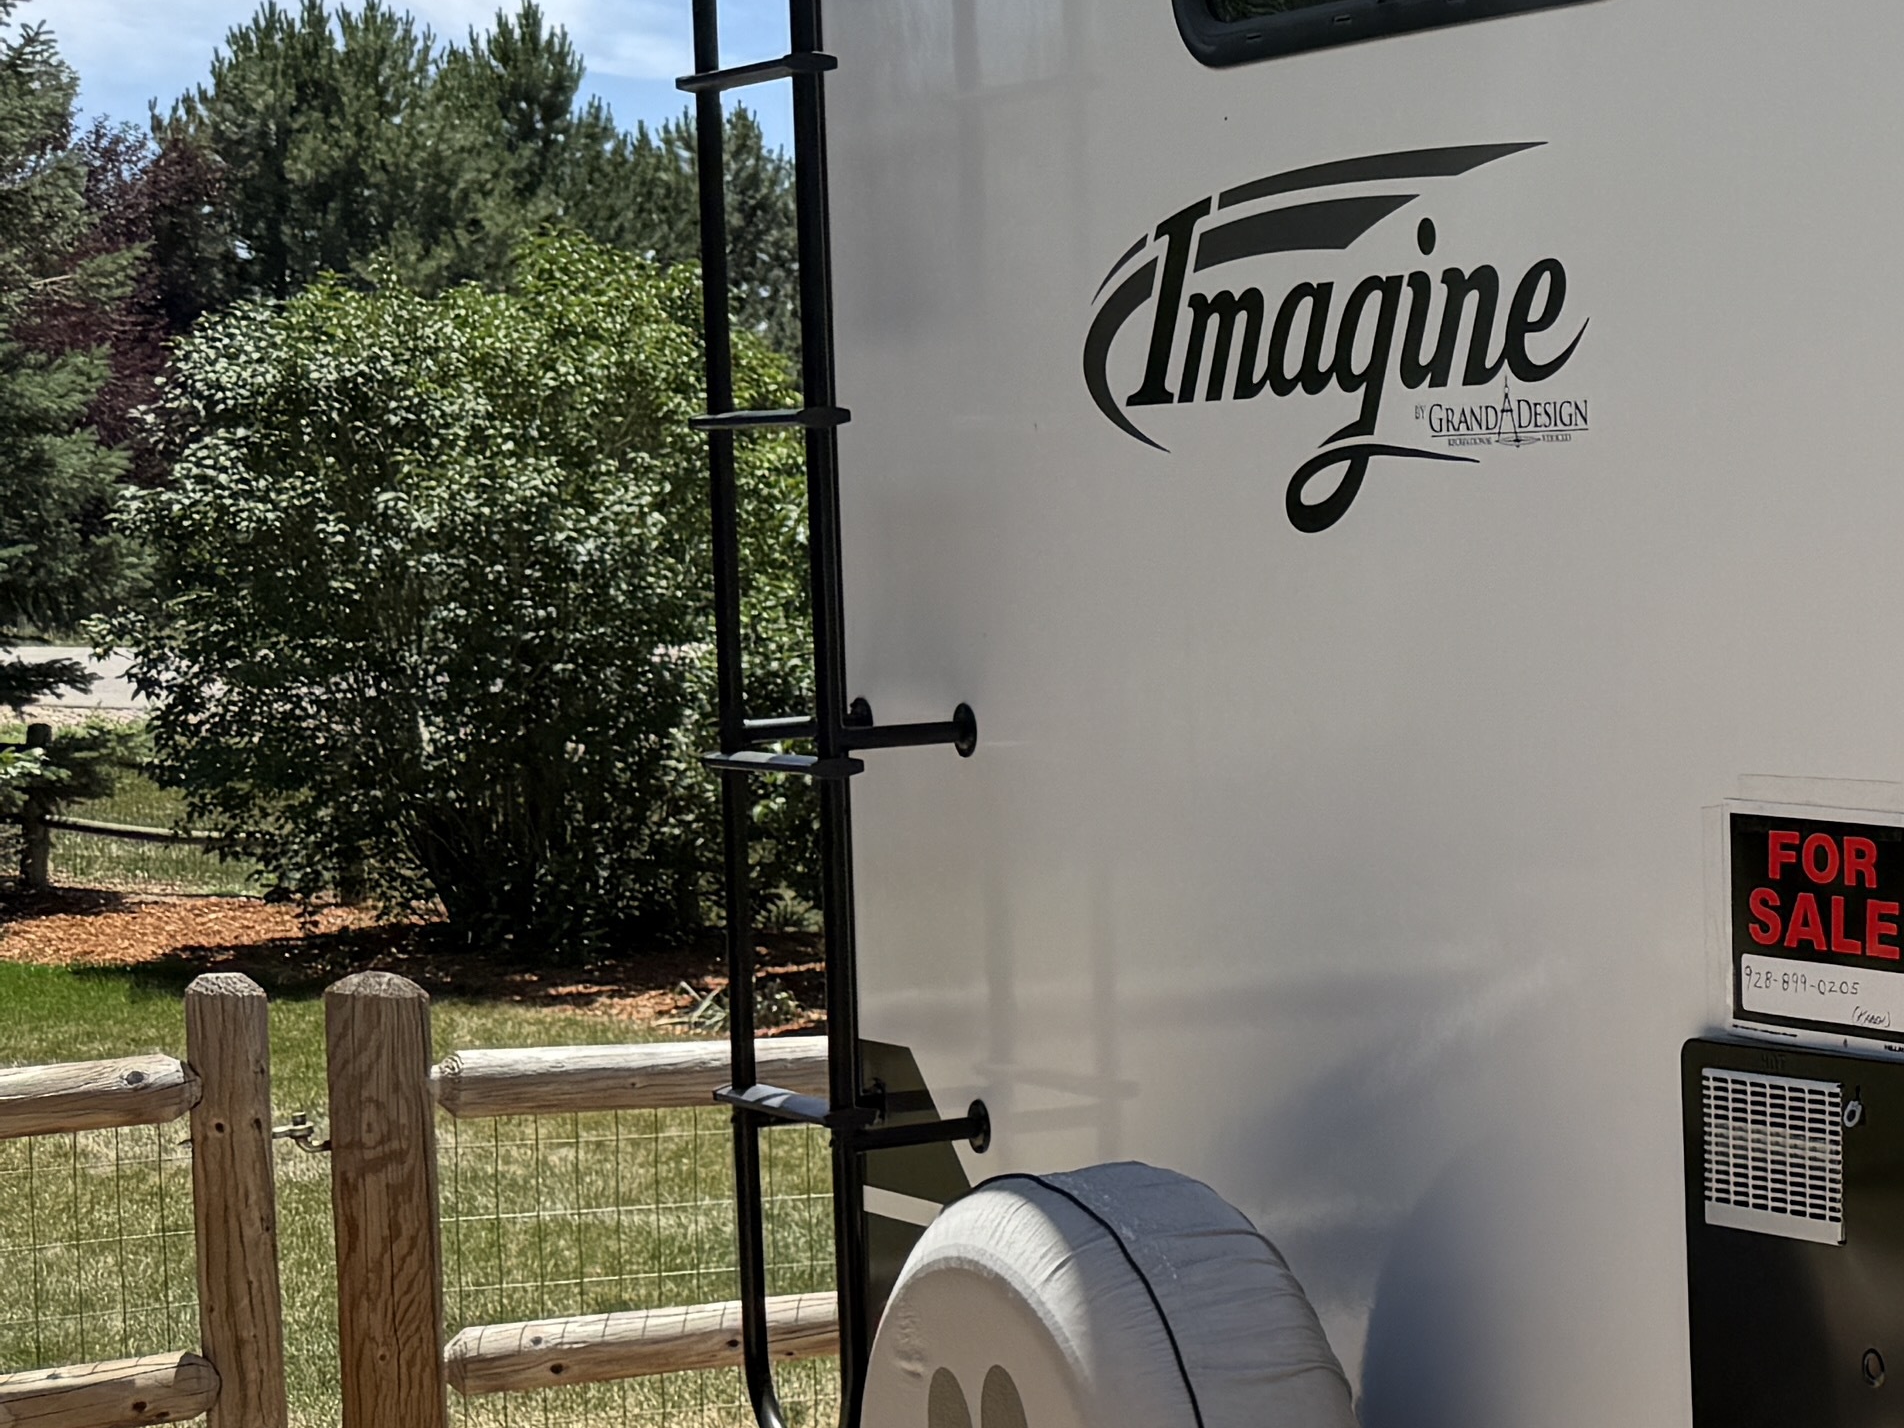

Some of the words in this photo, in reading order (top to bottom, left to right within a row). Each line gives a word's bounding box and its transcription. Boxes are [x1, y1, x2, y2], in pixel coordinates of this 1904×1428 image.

[1126, 195, 1590, 534] Imagine
[1414, 404, 1426, 420] BY
[1428, 403, 1499, 434] GRAND
[1516, 399, 1589, 429] DESIGN
[1768, 830, 1878, 889] FOR
[1749, 887, 1900, 960] SALE
[1744, 965, 1860, 996] 928-899-0205
